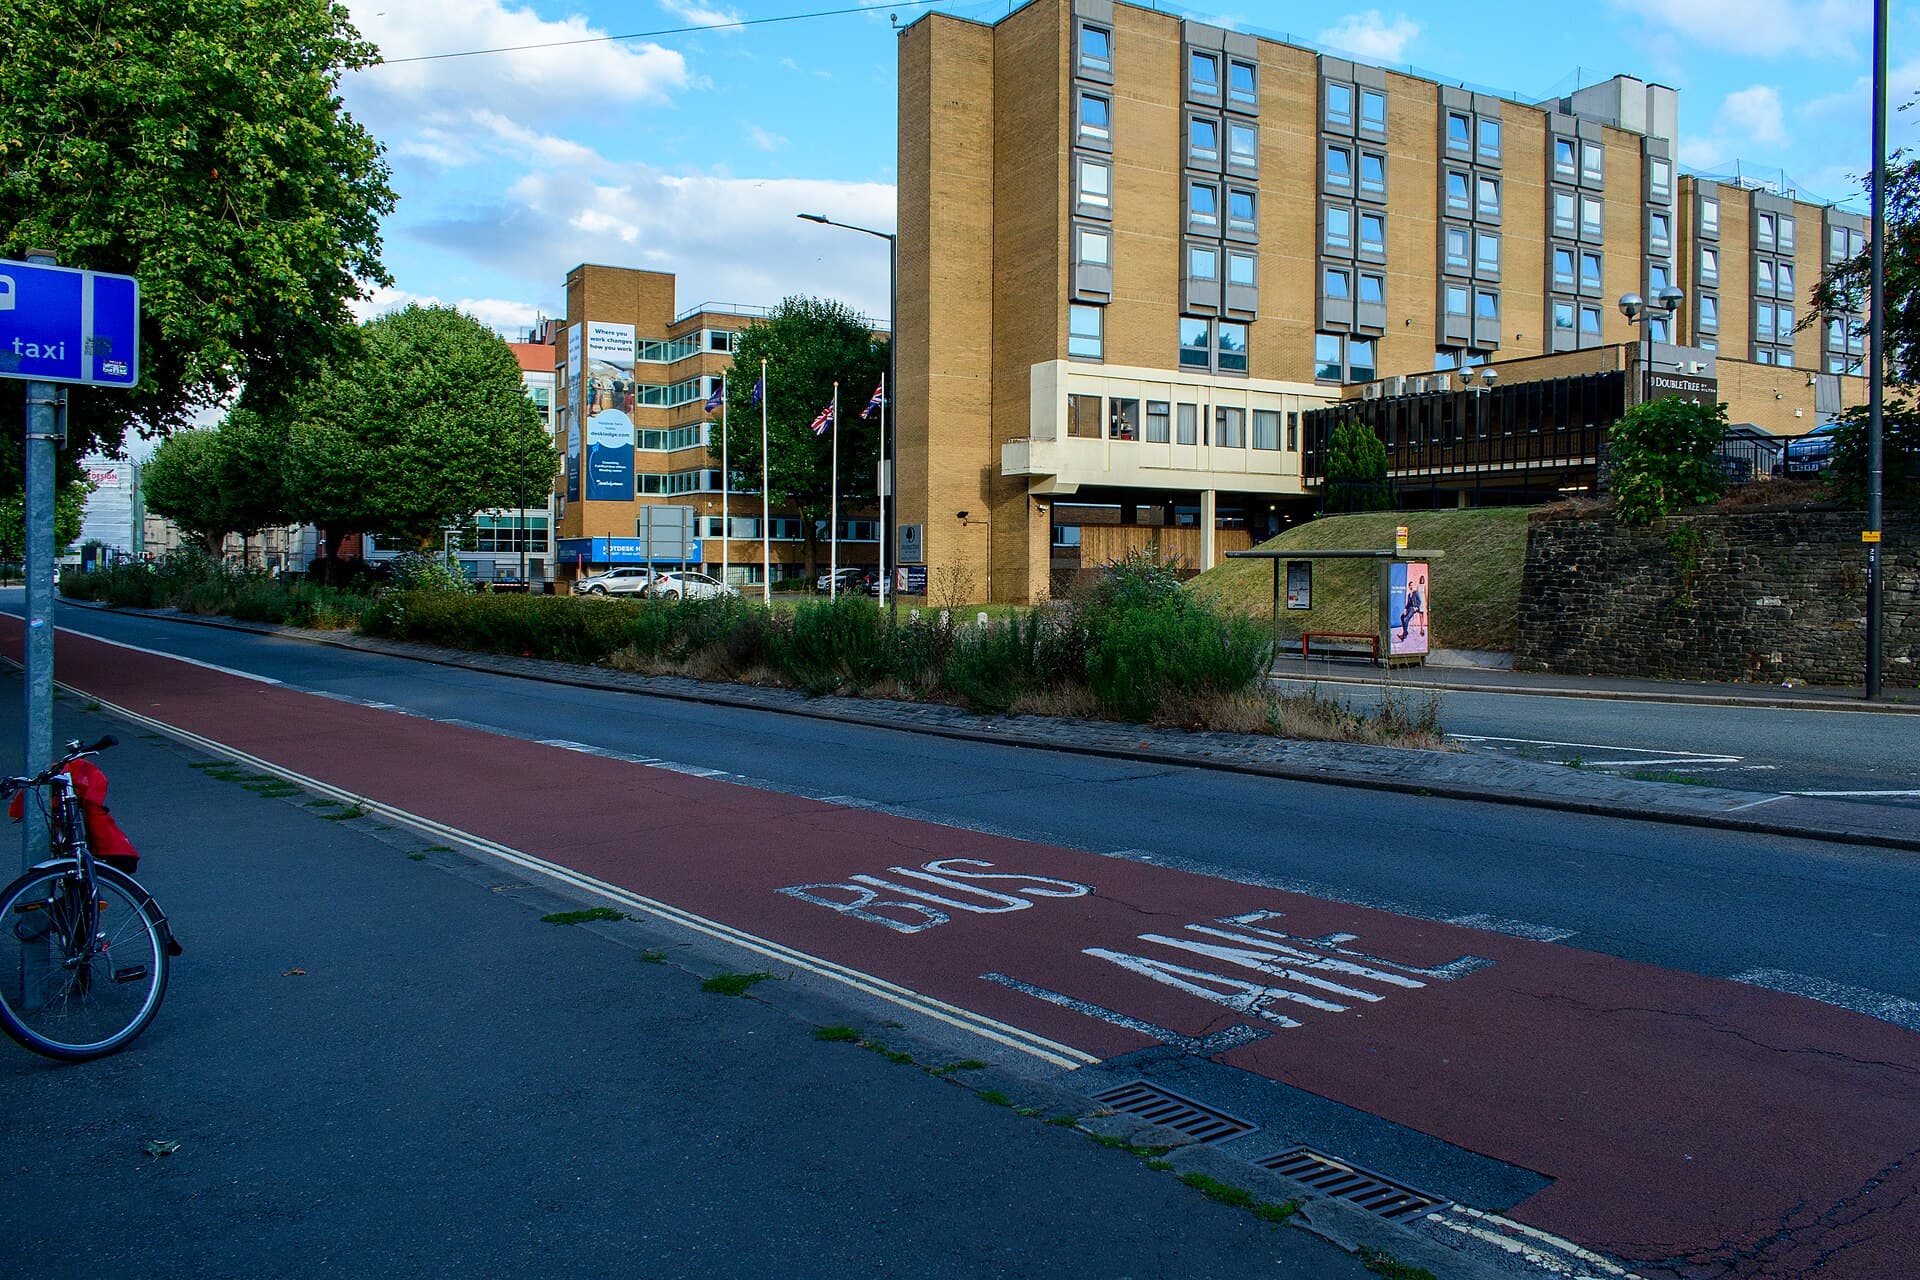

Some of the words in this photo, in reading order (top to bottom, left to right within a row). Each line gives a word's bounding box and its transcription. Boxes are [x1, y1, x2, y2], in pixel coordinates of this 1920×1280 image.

[12, 336, 65, 360] taxi
[1655, 376, 1700, 391] DOUBLETREE
[773, 857, 1098, 936] BUS
[978, 908, 1498, 1058] LANE
